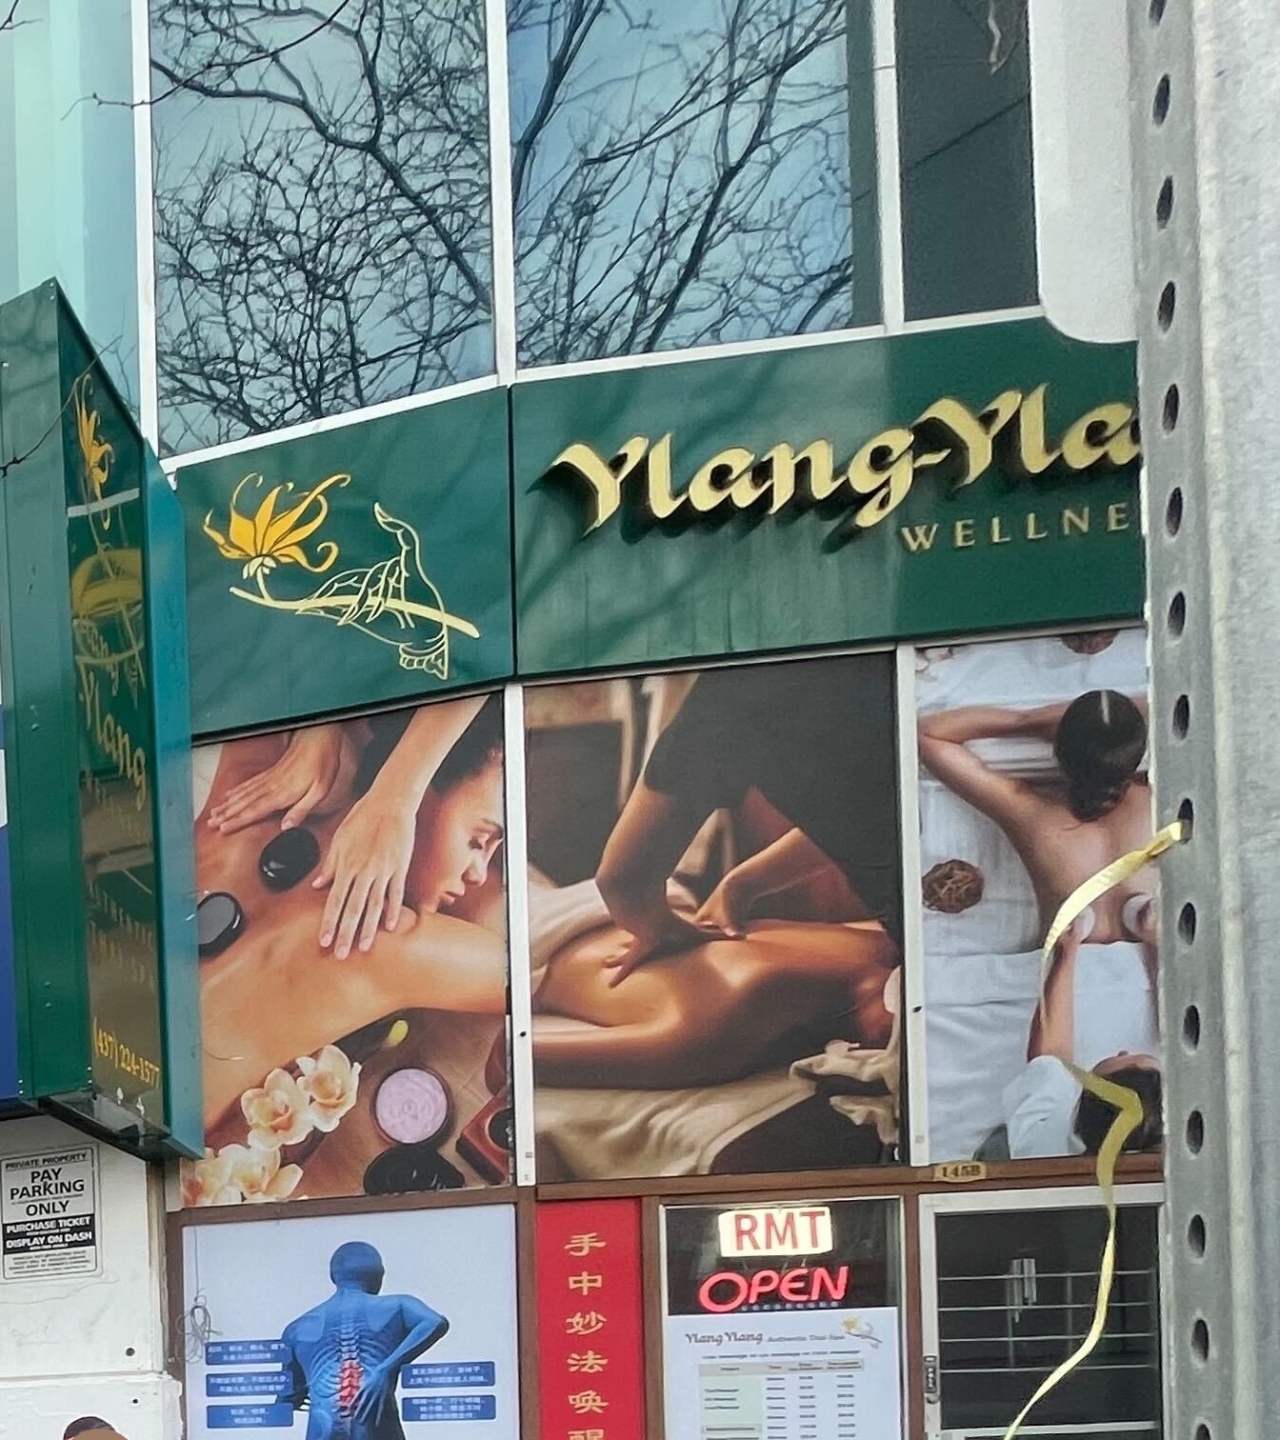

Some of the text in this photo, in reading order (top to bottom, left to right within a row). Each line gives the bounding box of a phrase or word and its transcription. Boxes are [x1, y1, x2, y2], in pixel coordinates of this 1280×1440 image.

[5, 1152, 88, 1170] PRIVATE PROPERTY
[31, 1167, 63, 1183] PAY
[10, 1179, 85, 1200] PARKING
[25, 1200, 70, 1217] ONLY
[6, 1219, 57, 1234] PURCHASE
[58, 1216, 91, 1228] TICKET
[734, 1211, 826, 1251] RMT
[6, 1236, 46, 1249] DISPLAY
[47, 1234, 63, 1244] ON
[65, 1231, 93, 1243] DASH
[698, 1265, 850, 1313] OPEN
[685, 1332, 724, 1346] Ylang
[724, 1331, 764, 1345] Ylang
